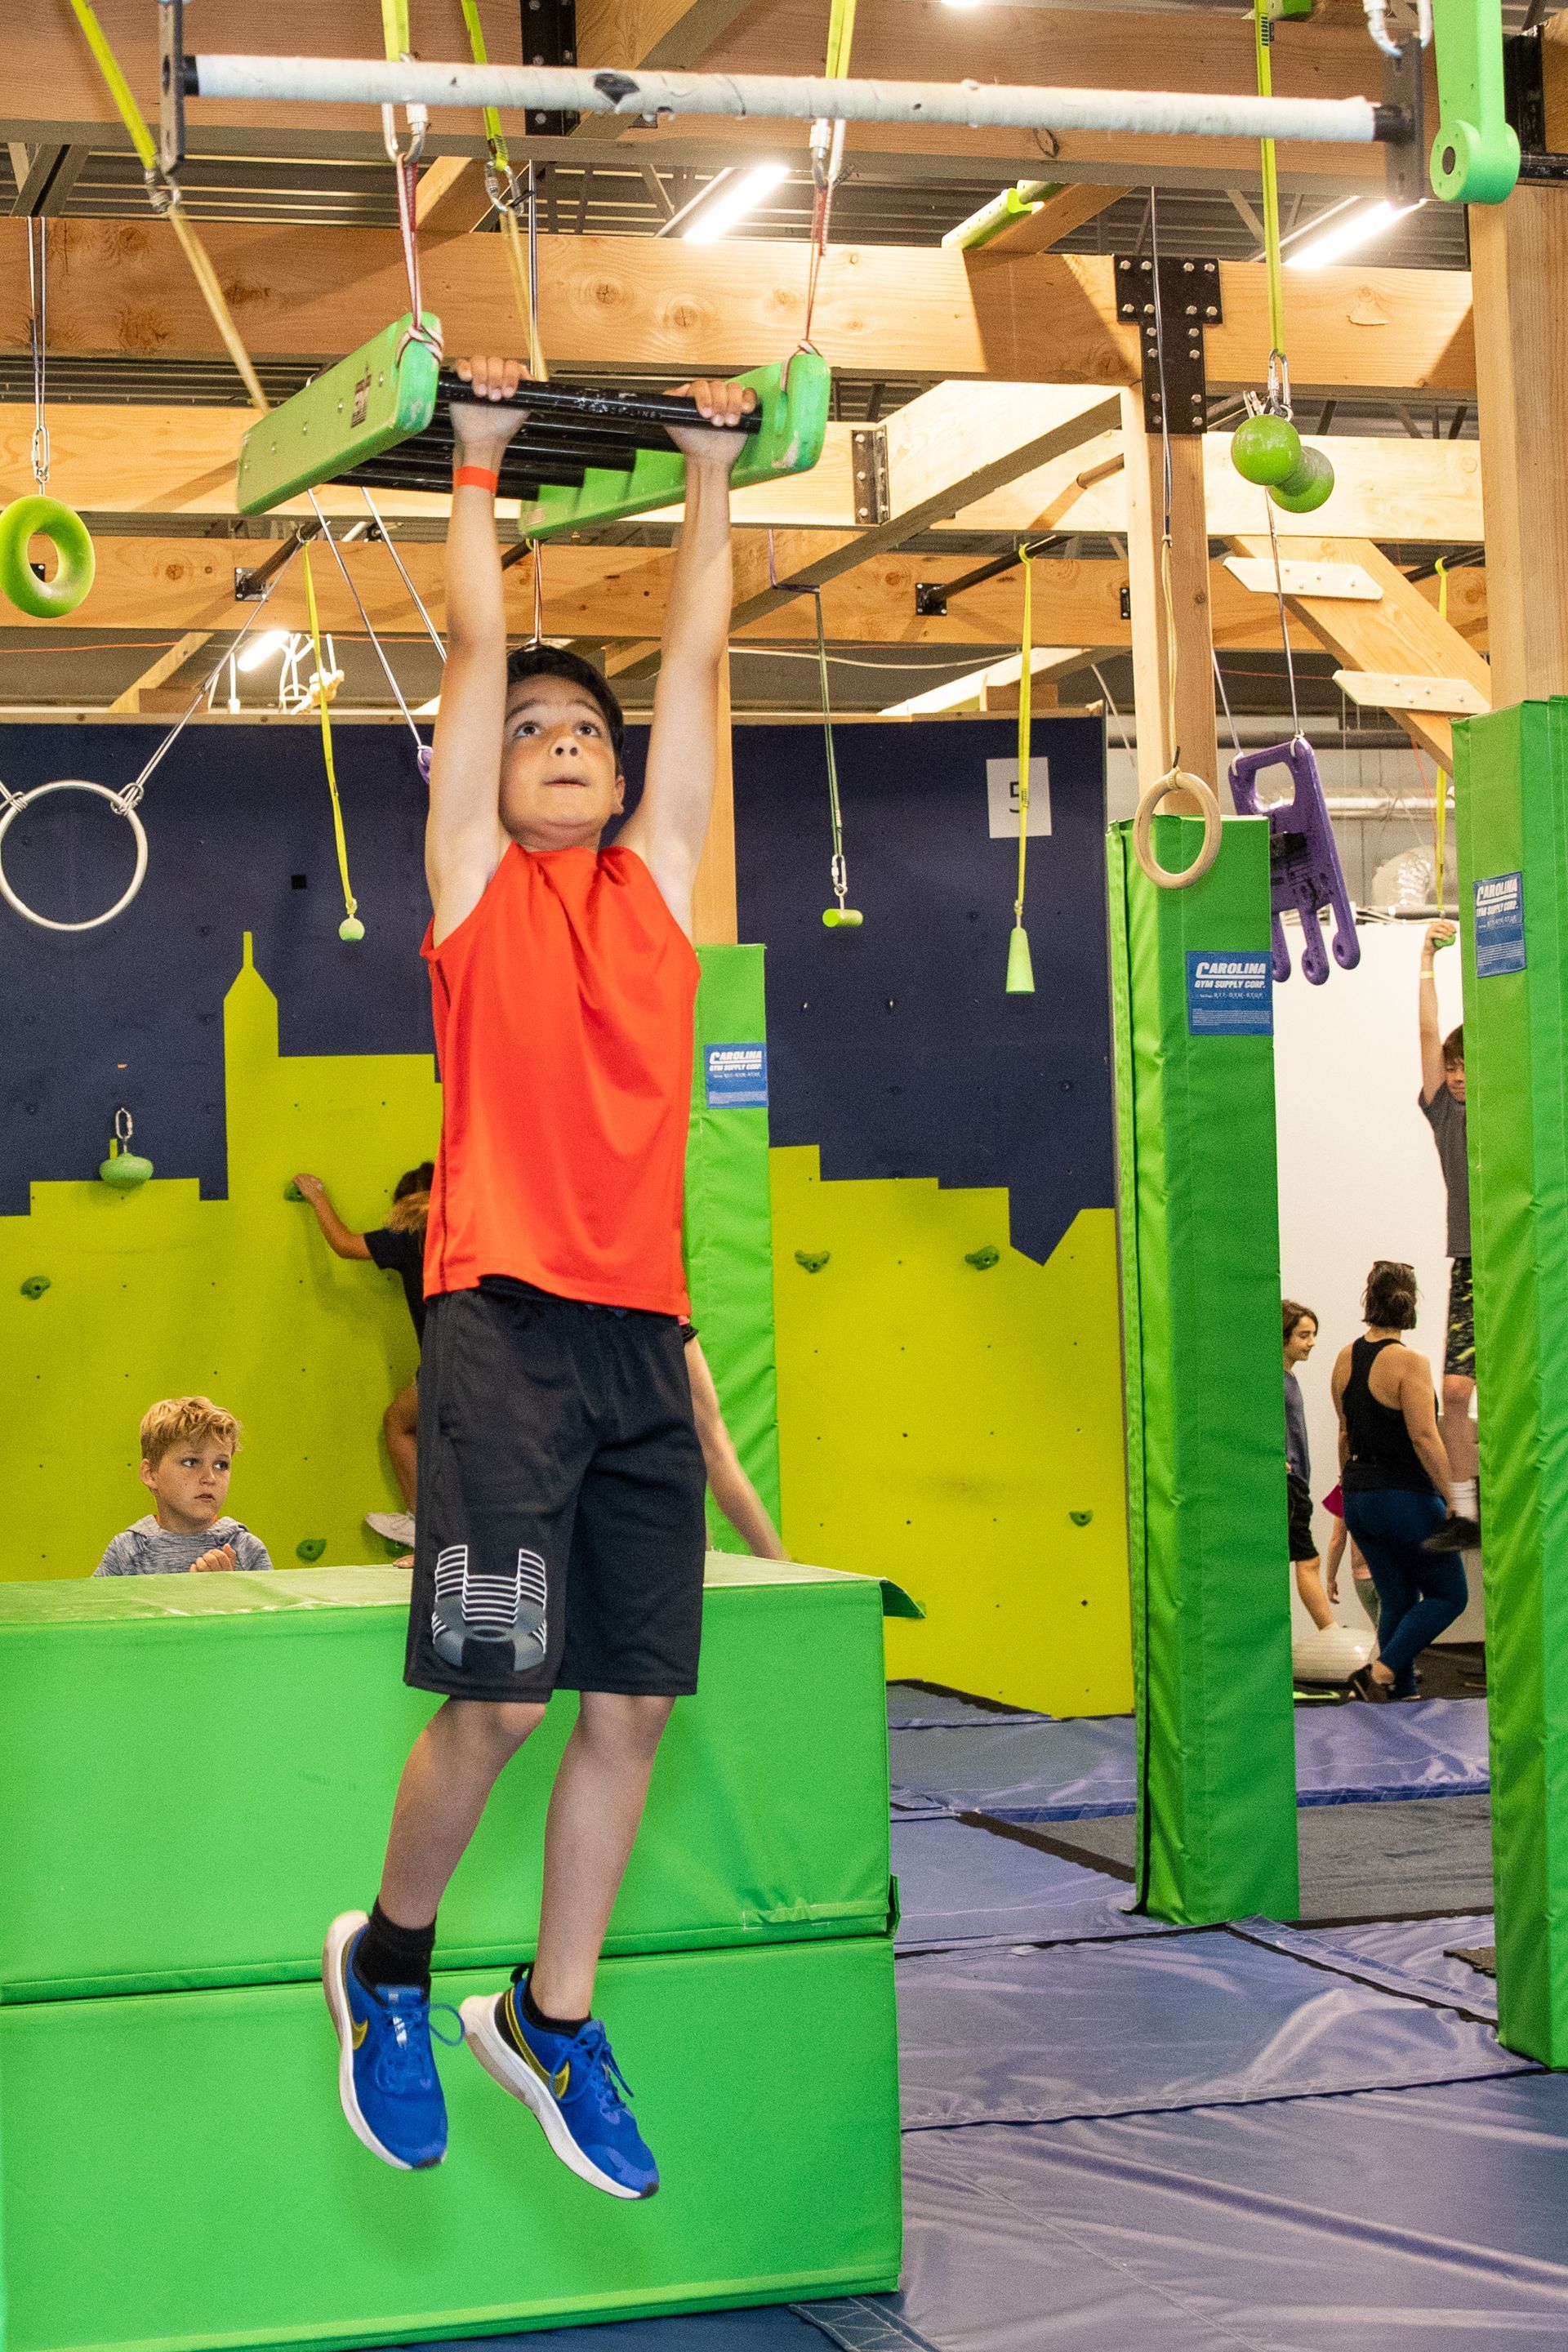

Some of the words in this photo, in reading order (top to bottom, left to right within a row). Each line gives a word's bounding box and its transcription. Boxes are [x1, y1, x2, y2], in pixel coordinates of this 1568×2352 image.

[1477, 878, 1518, 906] CAROLINA
[1196, 962, 1267, 979] CAROLINA
[1194, 980, 1214, 988] GYM
[1214, 980, 1244, 988] SUPPLY
[1244, 980, 1266, 988] CORP.
[709, 1050, 763, 1065] CAROLINA
